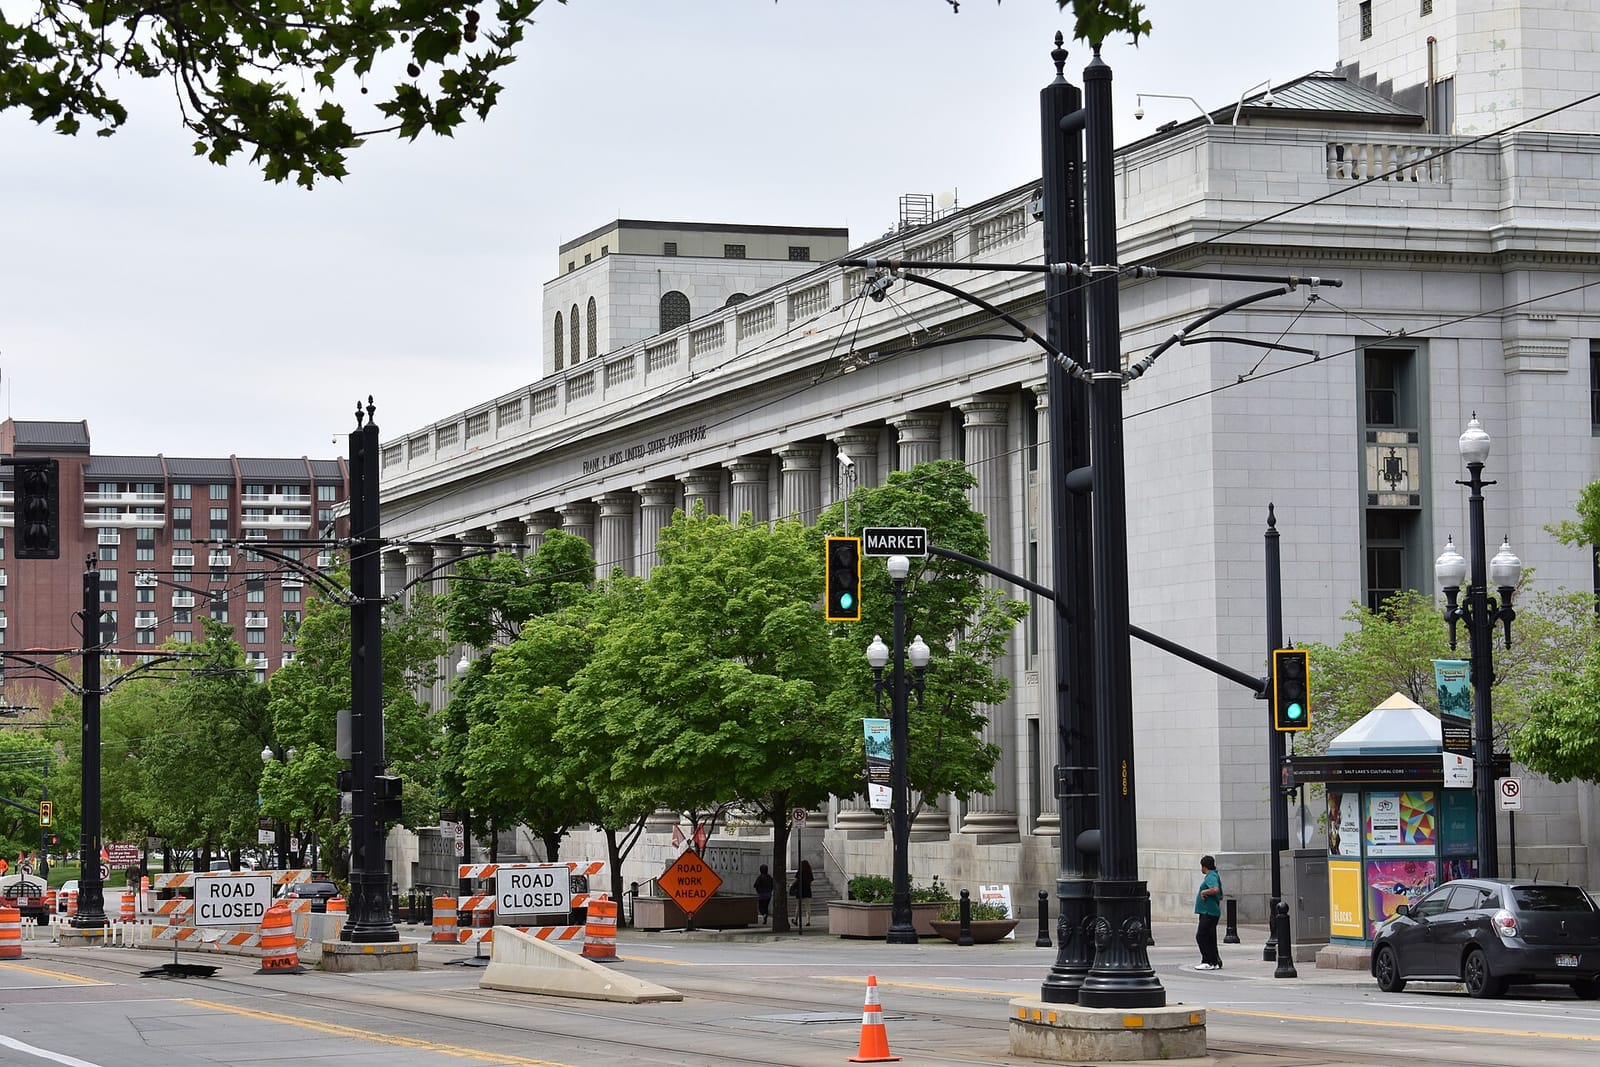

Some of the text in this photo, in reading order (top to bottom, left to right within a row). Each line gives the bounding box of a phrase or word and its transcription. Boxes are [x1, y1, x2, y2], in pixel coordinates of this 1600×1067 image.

[624, 444, 645, 461] UNITED
[648, 437, 666, 454] STATES
[669, 425, 707, 449] COURTHOUSE
[867, 535, 923, 549] MARKET
[677, 864, 702, 872] ROAD
[511, 874, 553, 888] ROAD
[677, 877, 702, 885] WORK
[210, 883, 255, 898] ROAD
[675, 889, 706, 898] AHEAD
[503, 893, 563, 908] CLOSED
[201, 902, 264, 918] CLOSED
